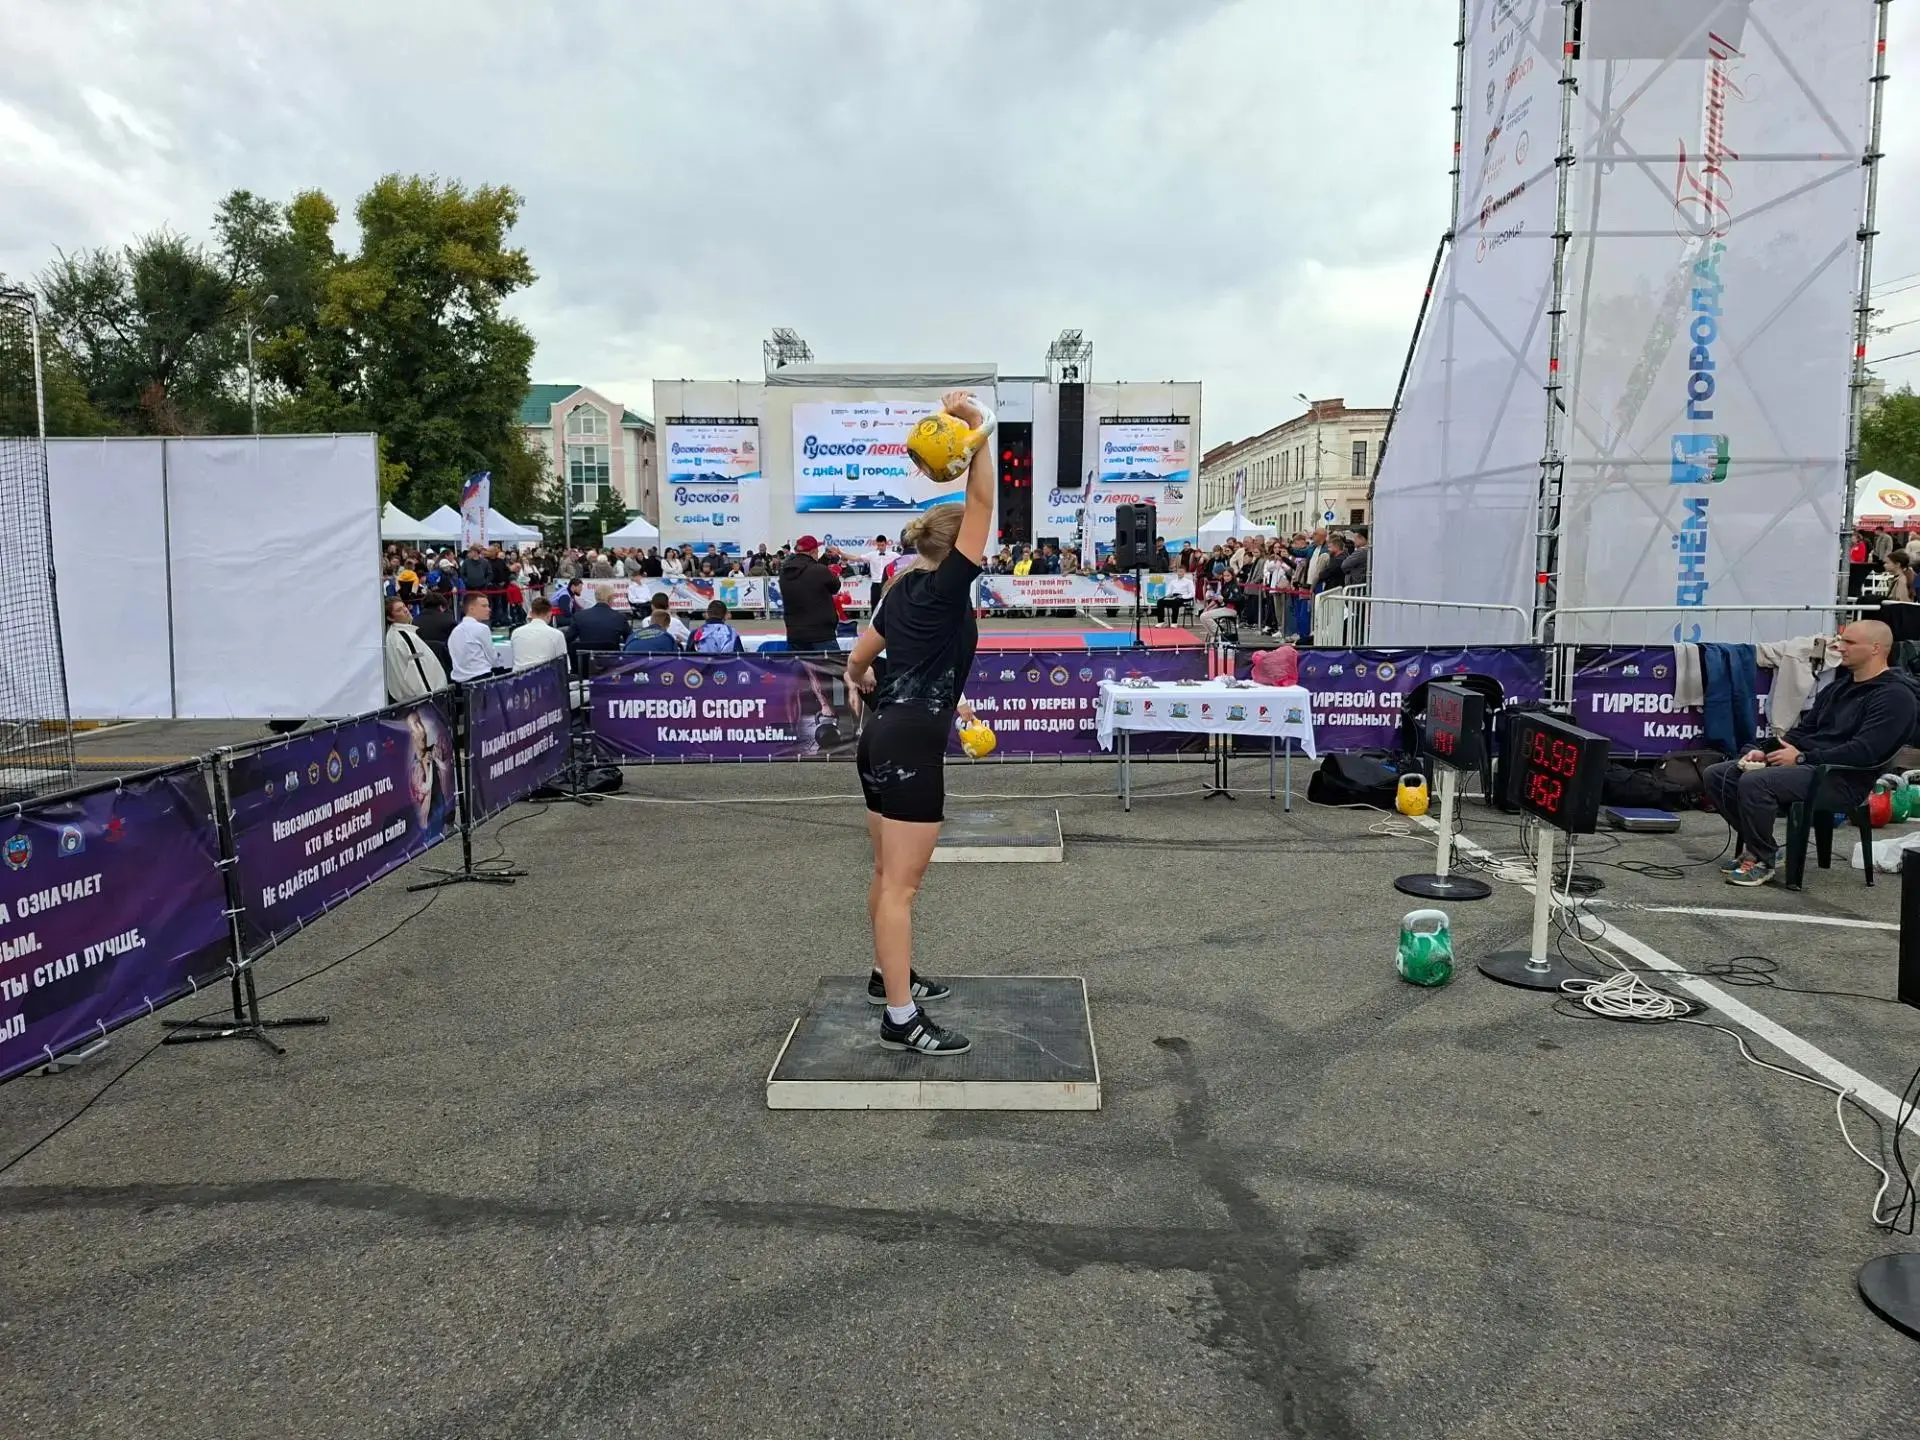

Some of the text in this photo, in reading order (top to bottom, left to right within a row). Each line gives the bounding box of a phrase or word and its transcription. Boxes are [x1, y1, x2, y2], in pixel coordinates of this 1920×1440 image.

[1686, 242, 1727, 420] ГОРОДА,
[803, 435, 866, 459] Русское
[813, 465, 843, 477] ДНЁМ
[863, 467, 908, 477] ГОРОДА,
[674, 487, 729, 506] Русское
[1048, 488, 1140, 507] Русске лето
[1055, 514, 1083, 524] ДНЁ
[1672, 497, 1710, 607] ДНЁМ
[608, 696, 766, 719] ГИРЕВОЙ СПОРТ
[1003, 699, 1026, 710] КТО
[1031, 698, 1075, 711] УВЕРЕН
[1080, 698, 1087, 709] В
[994, 719, 1020, 731] ИЛИ
[1024, 719, 1075, 733] ПОЗДНО
[1328, 713, 1391, 727] СИЛЬНЫХ
[1643, 721, 1704, 740] КАЖД
[334, 784, 374, 814] ПОБЕДИТЬ
[373, 776, 393, 797] ТОГО,
[1530, 772, 1562, 812] 152
[304, 808, 373, 857] КТО НЕ СДАЁТСЯ!
[278, 864, 320, 900] СДАЁТСЯ
[320, 856, 339, 877] ТОТ,
[339, 846, 354, 868] КТО
[356, 831, 384, 860] ДУХОМ
[384, 818, 406, 842] СИЛЁН
[17, 873, 102, 918] ОЗНАЧАЕТ
[1, 928, 146, 1001] ТЫ СТАЛ ЛУЧШЕ,
